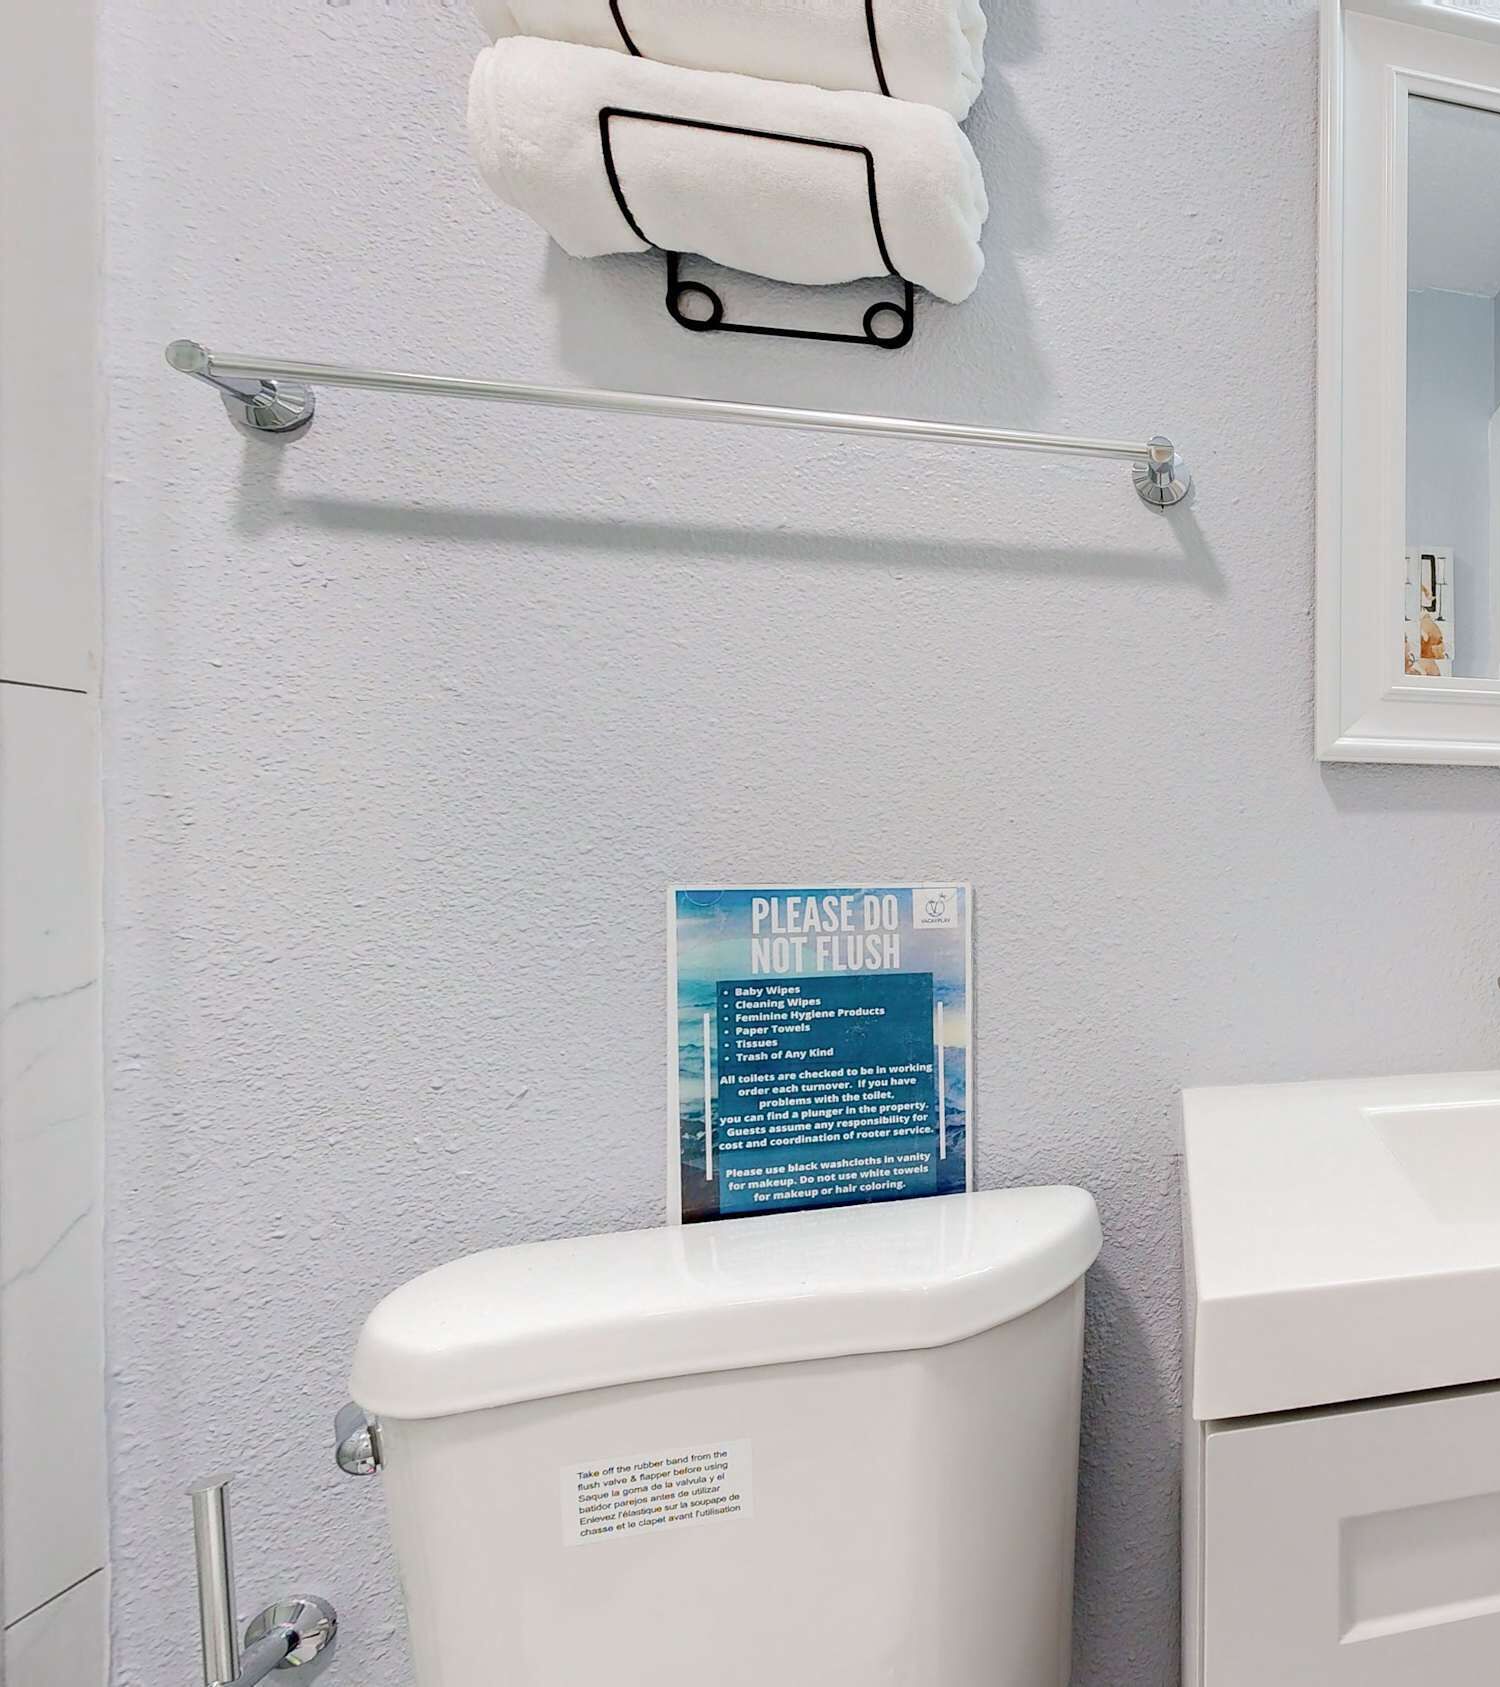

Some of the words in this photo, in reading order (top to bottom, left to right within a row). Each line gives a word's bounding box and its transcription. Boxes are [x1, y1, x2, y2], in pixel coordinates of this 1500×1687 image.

[752, 895, 855, 934] PLEASE
[863, 894, 898, 932] DO
[752, 935, 807, 974] NOT
[816, 933, 900, 972] FLUSH
[735, 987, 763, 997] Baby
[766, 986, 801, 996] Wipes
[735, 999, 785, 1009] Cleaning
[787, 998, 821, 1008] Wipes
[735, 1012, 787, 1022] Feminine
[790, 1010, 836, 1021] Hygiene
[837, 1007, 885, 1017] Products
[735, 1026, 769, 1037] Paper
[772, 1023, 810, 1033] Towels
[736, 1040, 778, 1049] Tissues
[736, 1052, 768, 1062] Trash
[771, 1050, 782, 1059] of
[785, 1049, 807, 1059] Any
[809, 1048, 834, 1057] Kind
[720, 1075, 735, 1085] All
[738, 1073, 775, 1083] toilets
[778, 1072, 796, 1080] are
[798, 1068, 844, 1079] checked
[846, 1068, 858, 1076] to
[860, 1067, 874, 1075] be
[876, 1065, 886, 1074] in
[889, 1063, 933, 1073] working
[738, 1087, 770, 1096] order
[772, 1084, 798, 1094] each
[801, 1082, 853, 1092] turnover.
[858, 1079, 866, 1088] If
[868, 1079, 888, 1089] you
[890, 1077, 917, 1085] have
[759, 1097, 812, 1110] problems
[814, 1094, 839, 1104] with
[842, 1093, 860, 1102] the
[862, 1091, 895, 1100] toilet,
[719, 1116, 741, 1126] you
[744, 1114, 764, 1122] can
[766, 1111, 789, 1120] find
[801, 1108, 844, 1120] plunger
[846, 1106, 856, 1114] in
[859, 1105, 877, 1113] the
[879, 1102, 929, 1114] property.
[727, 1126, 766, 1136] Guests
[769, 1123, 812, 1133] assume
[814, 1122, 834, 1130] any
[836, 1115, 910, 1128] responsibility
[718, 1141, 744, 1150] cost
[745, 1138, 767, 1148] and
[769, 1133, 840, 1146] coordination
[843, 1131, 855, 1140] of
[856, 1129, 891, 1139] rooter
[893, 1126, 934, 1136] service.
[726, 1168, 763, 1178] Please
[765, 1166, 785, 1174] use
[788, 1162, 818, 1172] black
[820, 1157, 882, 1169] washcloths
[884, 1155, 894, 1163] in
[896, 1152, 930, 1162] vanity
[728, 1182, 746, 1191] for
[748, 1179, 797, 1189] makeup.
[800, 1175, 814, 1184] Do
[817, 1173, 836, 1182] not
[838, 1172, 857, 1180] use
[860, 1169, 891, 1178] white
[893, 1164, 929, 1175] towels
[753, 1192, 771, 1202] for
[773, 1189, 818, 1200] makeup
[820, 1187, 834, 1195] or
[835, 1184, 857, 1194] hair
[860, 1180, 906, 1192] coloring.
[576, 1471, 599, 1479] Take
[602, 1466, 614, 1475] off
[616, 1465, 631, 1473] the
[634, 1460, 663, 1470] rubber
[666, 1456, 688, 1466] band
[578, 1481, 600, 1490] flush
[602, 1477, 628, 1486] valve
[639, 1470, 671, 1480] flapper
[673, 1467, 702, 1476] before
[704, 1462, 728, 1471] using
[578, 1493, 609, 1503] Saque
[611, 1489, 620, 1497] la
[622, 1486, 648, 1496] goma
[709, 1475, 714, 1483] y
[717, 1472, 725, 1480] el
[579, 1503, 612, 1514] batidor
[650, 1493, 675, 1502] antes
[677, 1490, 689, 1498] de
[691, 1486, 720, 1496] utilizar
[664, 1503, 678, 1511] sur
[680, 1501, 688, 1509] la
[690, 1496, 727, 1507] soupape
[729, 1493, 740, 1501] de
[580, 1526, 614, 1537] chasse
[639, 1516, 666, 1526] clapet
[668, 1512, 693, 1521] avant
[696, 1505, 741, 1517] l'utilisation
